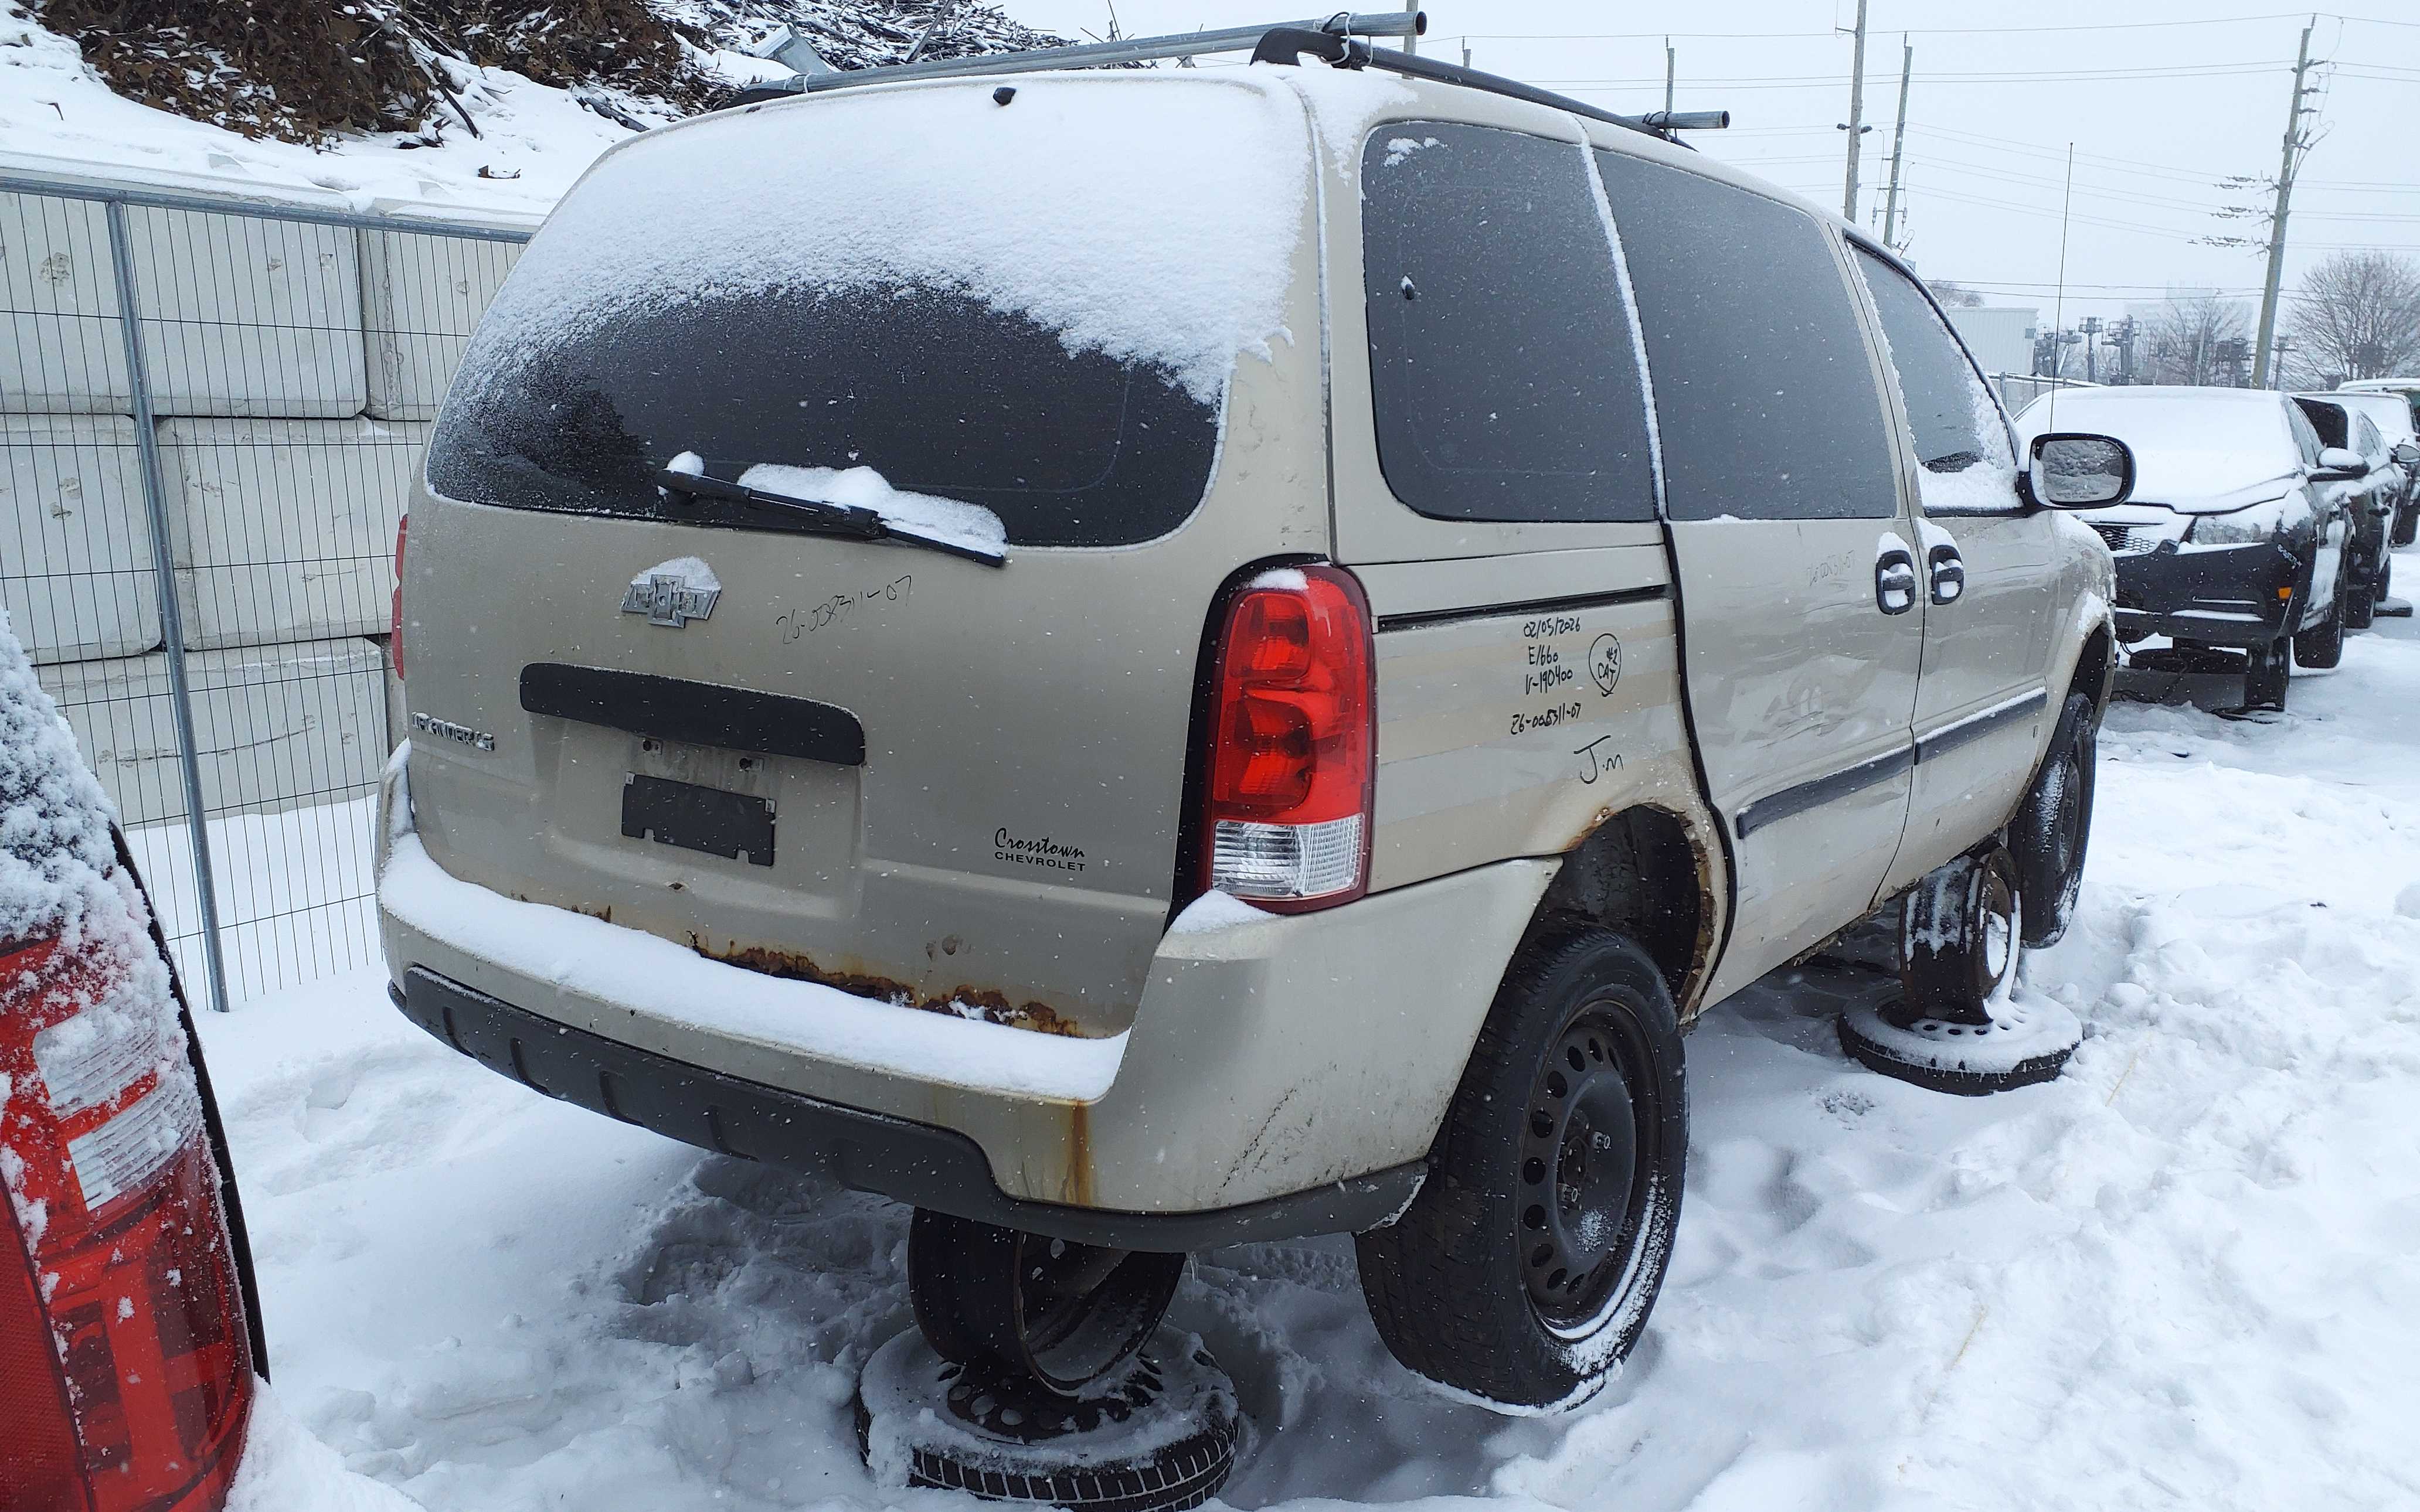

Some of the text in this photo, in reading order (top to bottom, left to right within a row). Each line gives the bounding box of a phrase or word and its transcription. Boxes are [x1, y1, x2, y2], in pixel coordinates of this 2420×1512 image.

[1524, 617, 1581, 639] 02/05/2026
[1598, 662, 1616, 685] CAT
[994, 827, 1085, 859] Crosstown
[994, 851, 1086, 871] CHEVROLET
